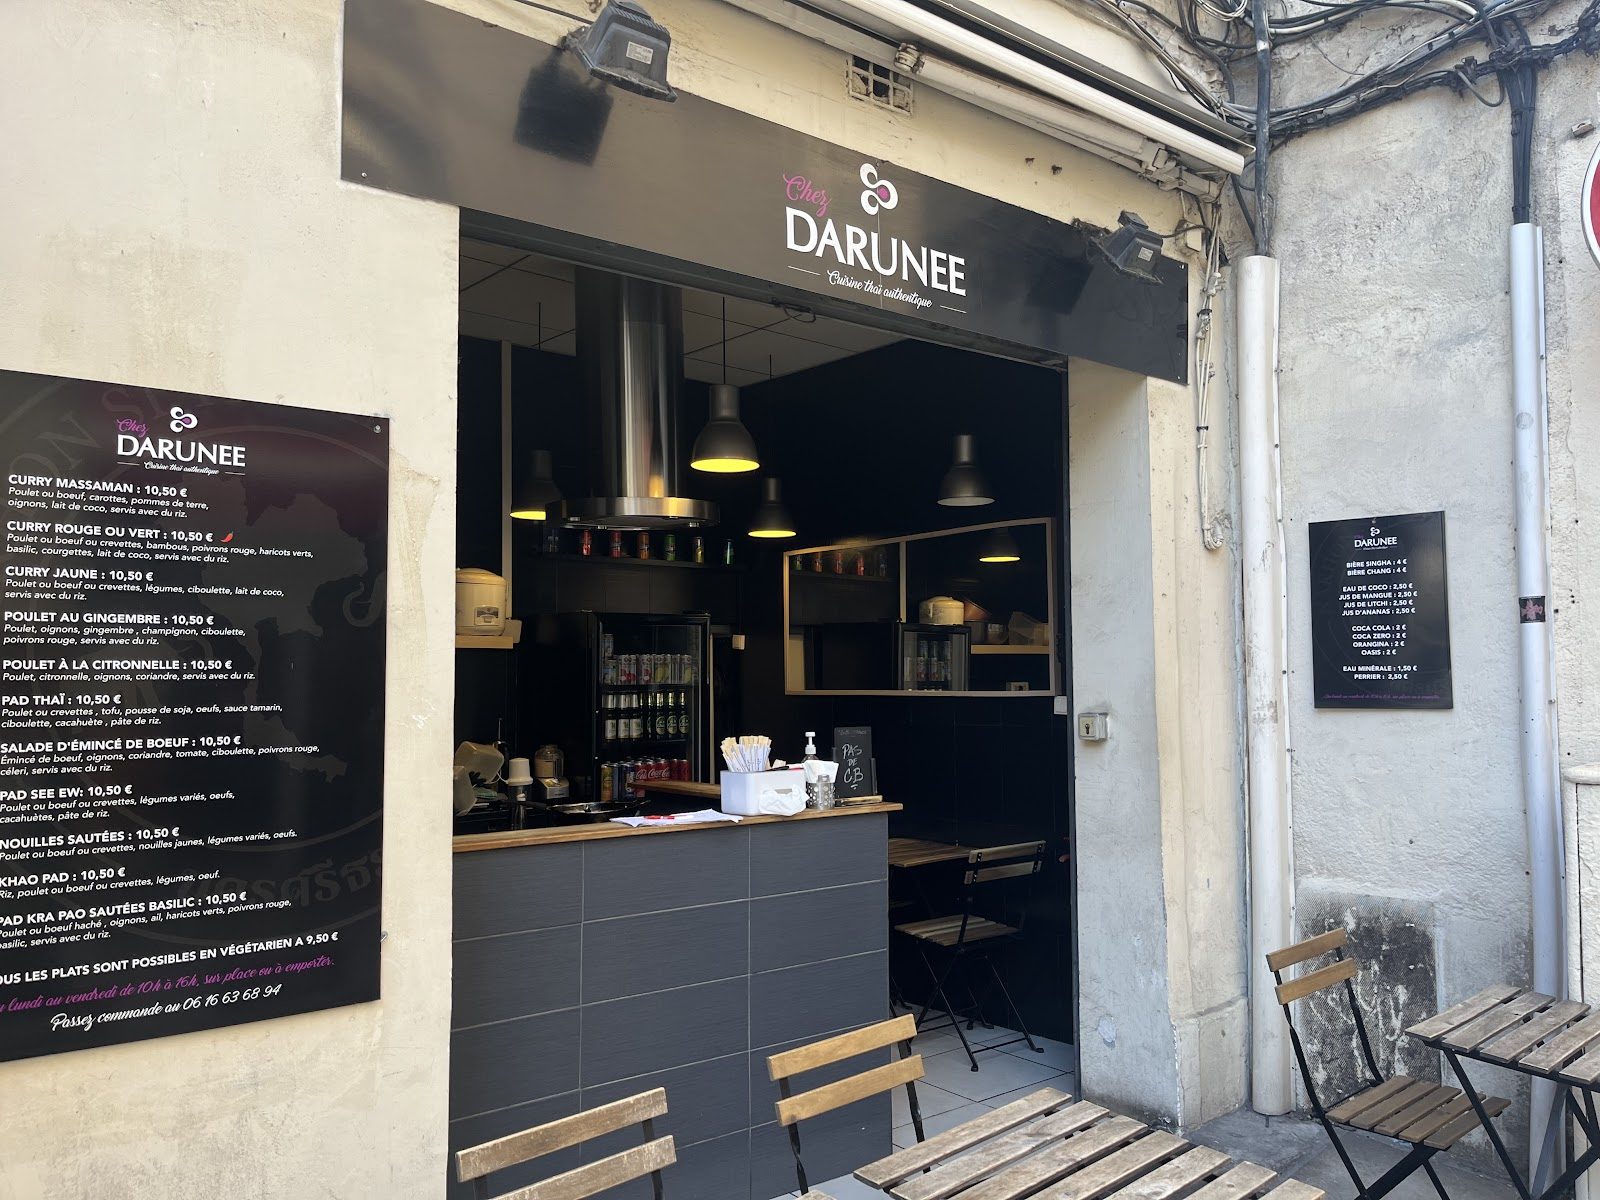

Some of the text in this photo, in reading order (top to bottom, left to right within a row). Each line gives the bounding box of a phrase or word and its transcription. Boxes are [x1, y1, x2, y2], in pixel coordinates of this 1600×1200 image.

[783, 174, 831, 217] Chez
[786, 206, 966, 296] DARUNEE
[827, 270, 932, 309] Cuisine thaï authentique
[117, 418, 148, 437] Chez
[118, 434, 246, 467] DARUNEE
[8, 474, 176, 496] CURRY MASSAMAN 10,50
[8, 486, 39, 496] Poulet
[56, 490, 86, 501] boeuf,
[89, 494, 128, 504] carottes,
[130, 498, 170, 506] pommes
[172, 499, 183, 507] de
[186, 501, 208, 510] terre,
[7, 520, 202, 541] CURRY ROUGE OU VERT 10,50
[1354, 537, 1397, 547] DARUNEE
[5, 566, 142, 581] CURRY JAUNE 10,50
[1366, 567, 1391, 575] CHANG
[4, 611, 203, 625] POULET AU GINGEMBRE 10,50
[3, 658, 222, 670] POULET À LA CITRONNELLE 10,50
[2, 672, 36, 681] Poulet,
[39, 672, 90, 681] citronnelle,
[93, 672, 132, 682] oignons,
[135, 672, 179, 680] coriandre,
[230, 671, 241, 679] du
[2, 693, 110, 705] PAD THAÏ 10,50
[1, 716, 161, 728] ciboulette, cacahuète pâte de riz.
[0, 736, 230, 753] SALADE D'ÉMINCÉ DE BOEUF 10,50
[842, 744, 862, 759] PAS
[847, 758, 857, 766] DE
[844, 768, 863, 783] CB
[0, 785, 121, 801] PAD SEE EW: 10,50
[0, 809, 109, 823] cacahuètes, pâte de riz.
[0, 828, 168, 849] NOUILLES SAUTÉES 10,50
[0, 868, 114, 887] KHAO PAD 10,50
[27, 912, 55, 924] KRA
[58, 908, 86, 920] PAO
[89, 902, 145, 917] SAUTÉES
[149, 897, 194, 911] BASILIC
[205, 892, 236, 904] 10,50
[25, 933, 329, 982] LES PLATS SONT POSSIBLES EN VÉGÉTARIEN A 9,50
[8, 954, 335, 1011] lundi au vendredi de 10h à 16h, sur place ou à emporter.
[50, 983, 282, 1031] Passez commande au 06 16 63 68 94
